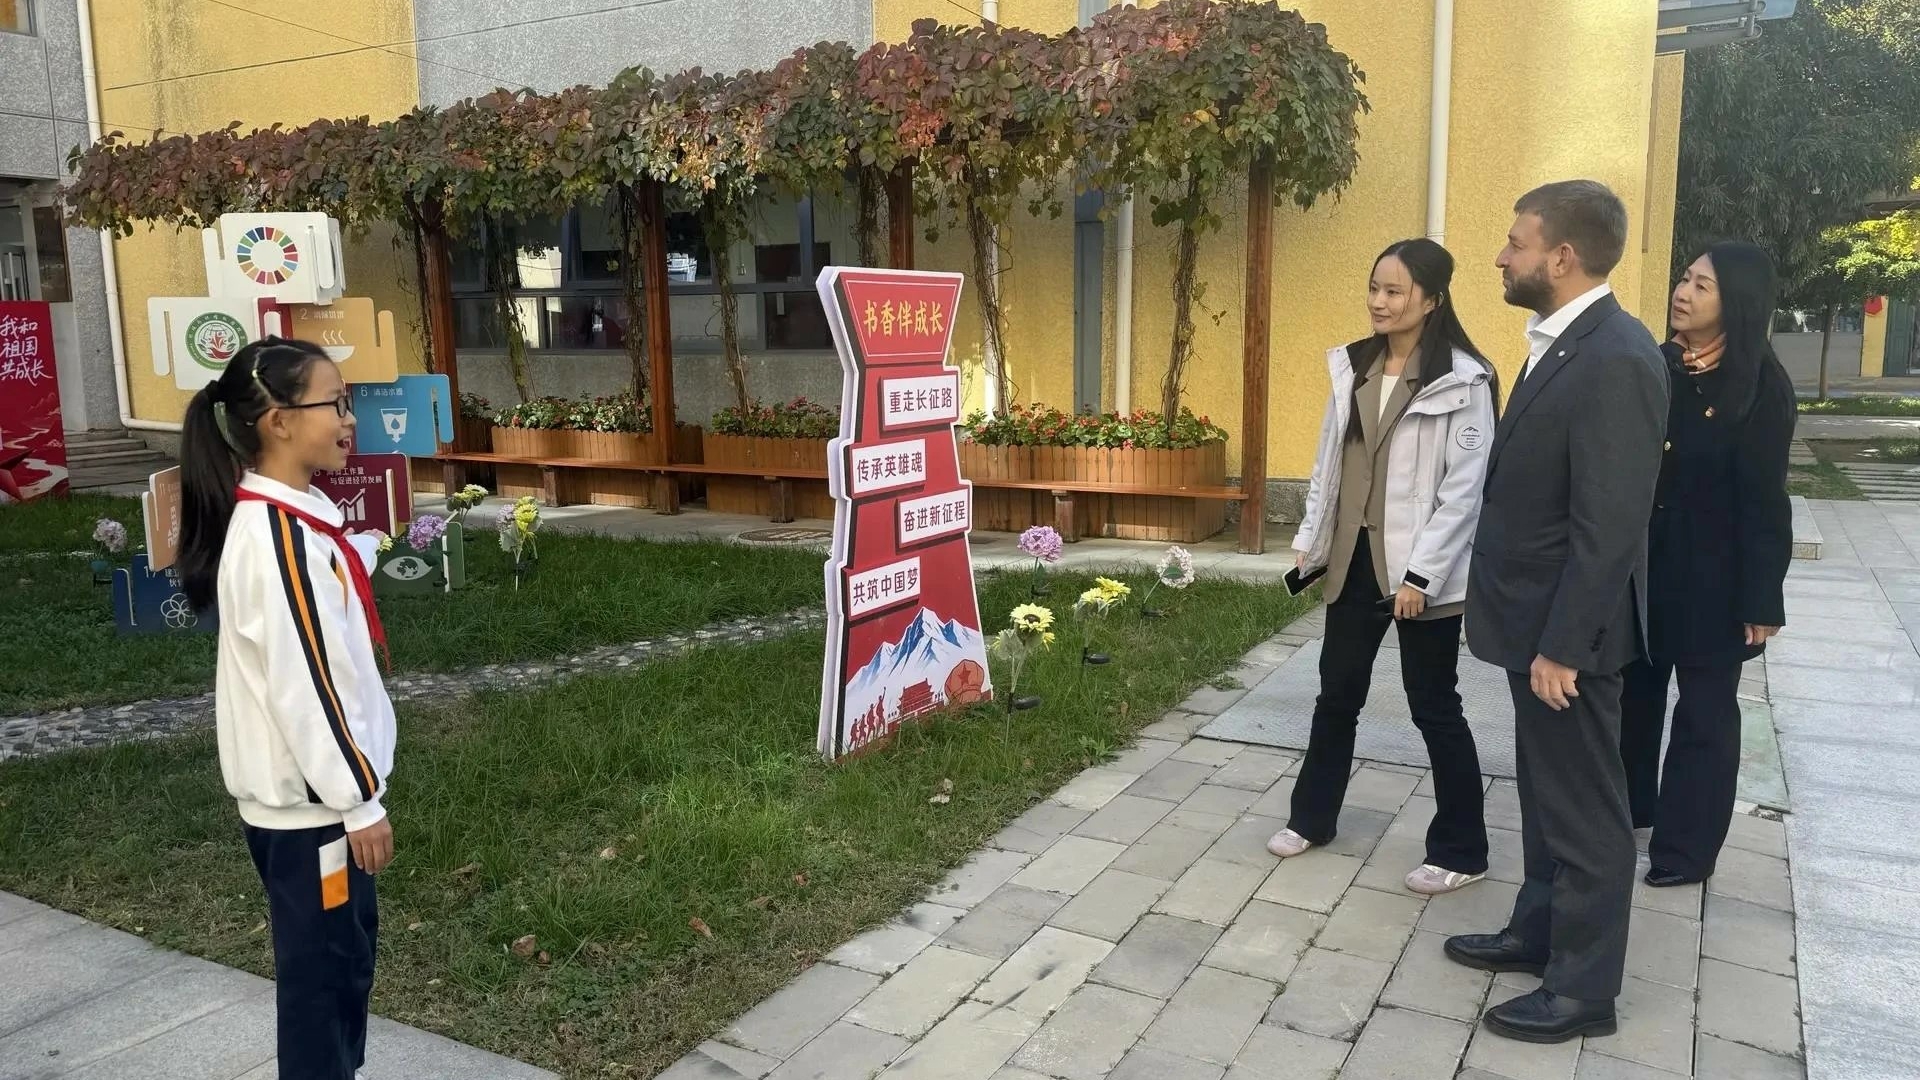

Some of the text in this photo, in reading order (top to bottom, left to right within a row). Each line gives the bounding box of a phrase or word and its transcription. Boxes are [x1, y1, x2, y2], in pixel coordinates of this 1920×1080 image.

[0, 314, 38, 339] 我和
[299, 308, 308, 320] 2
[863, 299, 944, 339] 书香伴成长
[0, 336, 38, 358] 祖国
[0, 355, 54, 387] 共成长
[360, 385, 368, 397] 6
[889, 387, 952, 414] 重走长征路
[857, 451, 923, 485] 传承英雄魂
[904, 500, 965, 532] 奋进新征程
[853, 567, 918, 606] 共筑中国梦
